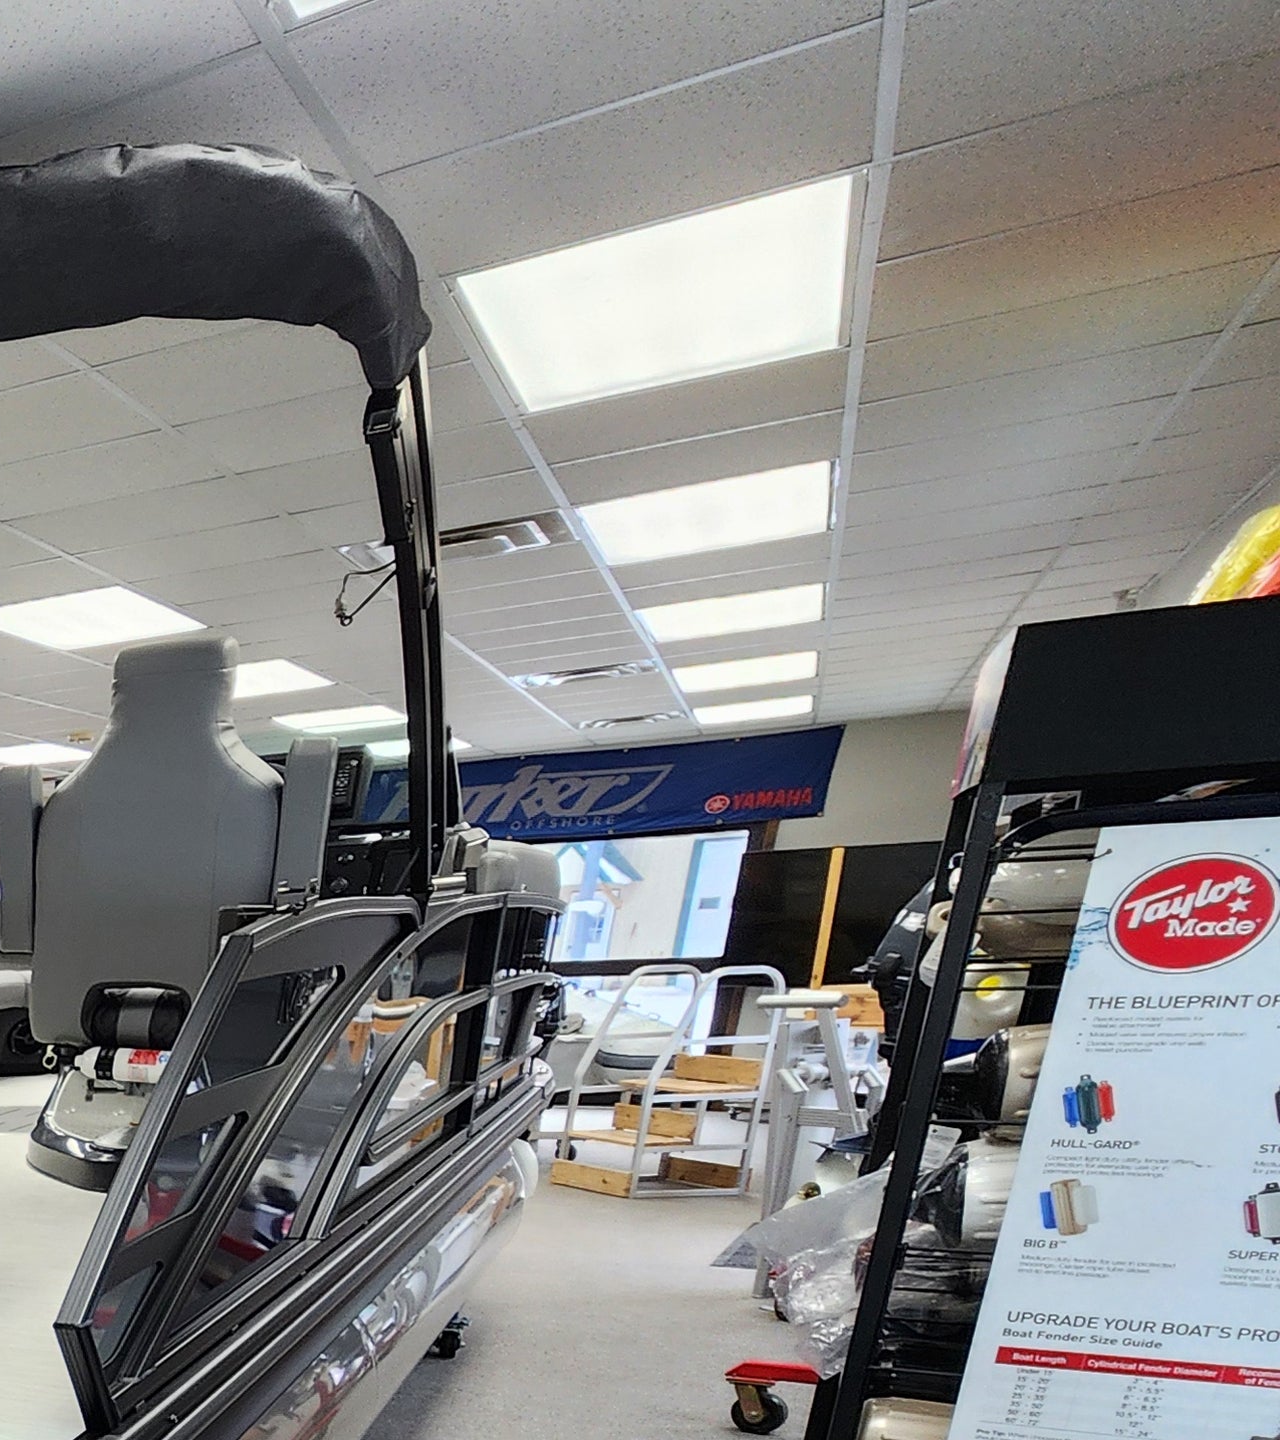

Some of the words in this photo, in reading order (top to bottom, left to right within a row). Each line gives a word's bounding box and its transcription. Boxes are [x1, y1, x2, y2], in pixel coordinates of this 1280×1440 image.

[732, 785, 814, 810] YAMAHA
[510, 815, 617, 831] OFFSHORE
[1124, 875, 1256, 929] Taylor
[1164, 917, 1257, 938] Made
[1088, 996, 1127, 1010] THE
[1131, 994, 1253, 1010] BLUEPRINT
[1023, 1238, 1047, 1248] BIG
[1228, 1249, 1280, 1261] SUPER
[1007, 1310, 1099, 1330] UPGRADE
[1104, 1317, 1156, 1334] YOUR
[1161, 1322, 1232, 1339] BOAT'S
[1002, 1327, 1033, 1339] Boat
[1037, 1330, 1086, 1343] Fender
[1090, 1333, 1120, 1346] Size
[1122, 1337, 1163, 1349] Guide
[1012, 1352, 1033, 1362] Boat
[1035, 1354, 1067, 1365] Length
[1087, 1358, 1137, 1371] Cylindrical
[1138, 1362, 1172, 1374] Fender
[1173, 1365, 1219, 1378] Diameter
